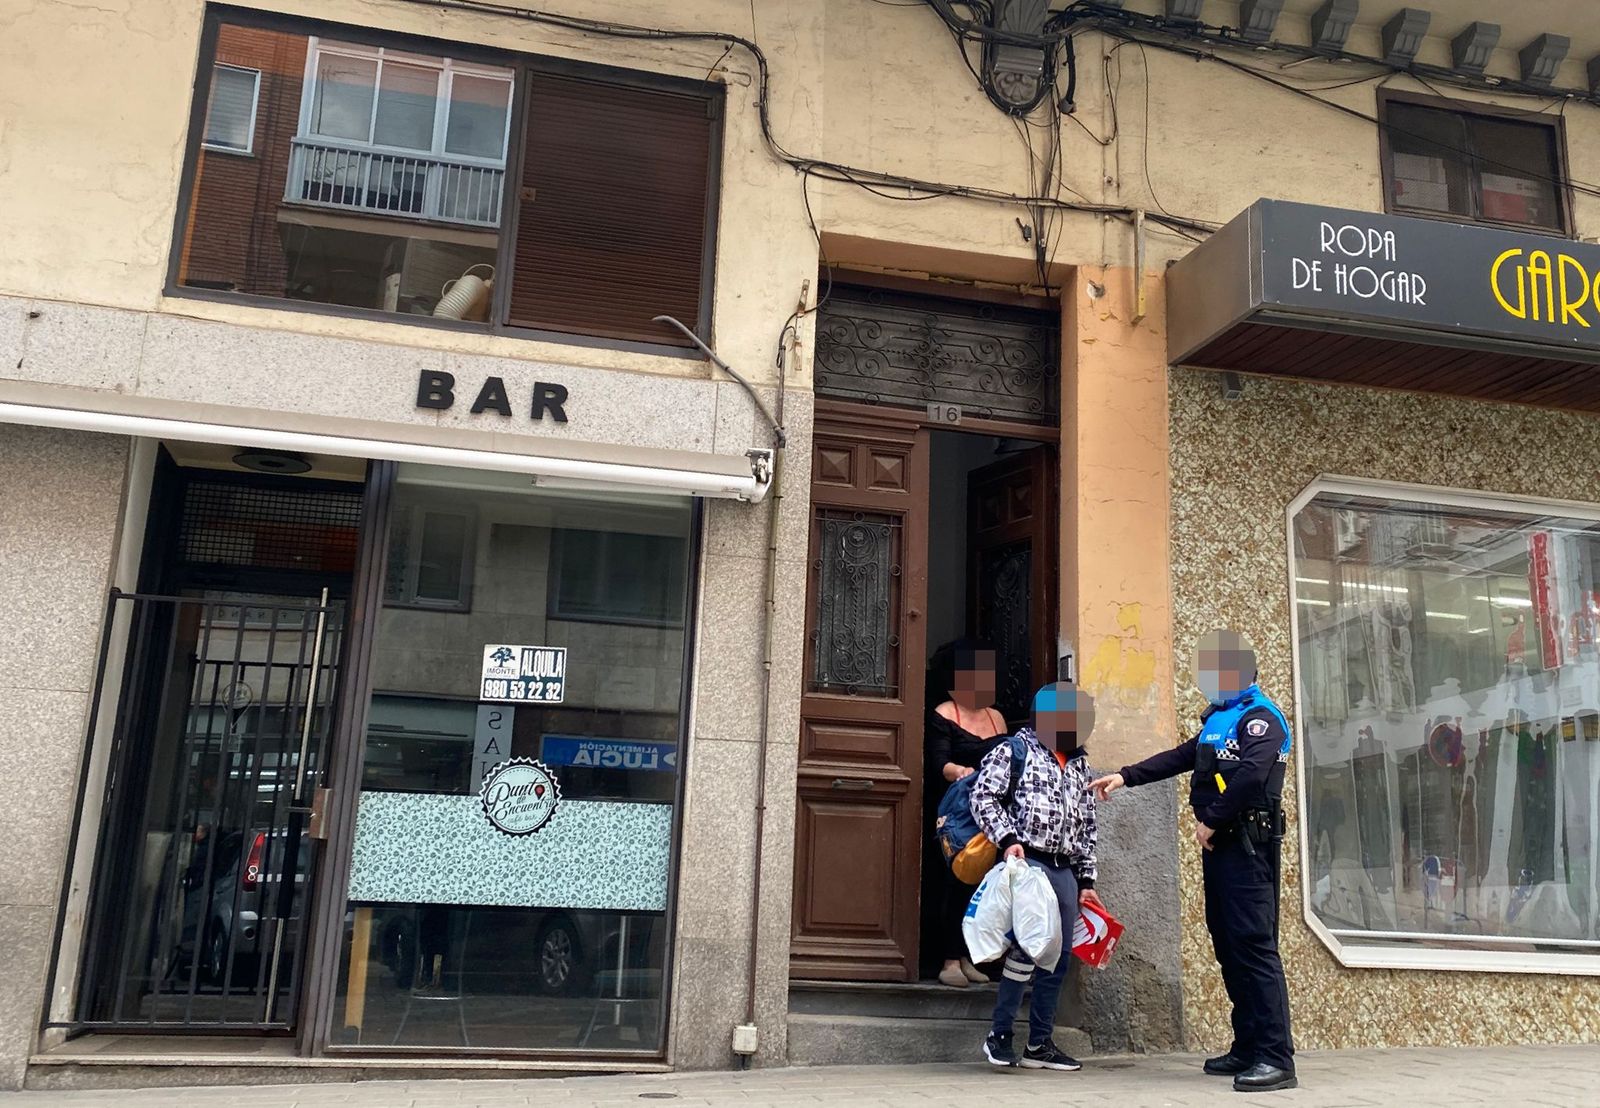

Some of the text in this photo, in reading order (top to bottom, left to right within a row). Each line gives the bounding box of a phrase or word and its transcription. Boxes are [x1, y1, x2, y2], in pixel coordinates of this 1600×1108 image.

[1320, 221, 1396, 262] ROPA
[1292, 257, 1427, 306] DE HOGAR
[416, 368, 569, 423] BAR
[933, 405, 958, 422] 16
[486, 667, 517, 675] IMONTE
[521, 650, 562, 681] ALQUILA
[484, 679, 562, 700] 980 53 22 32
